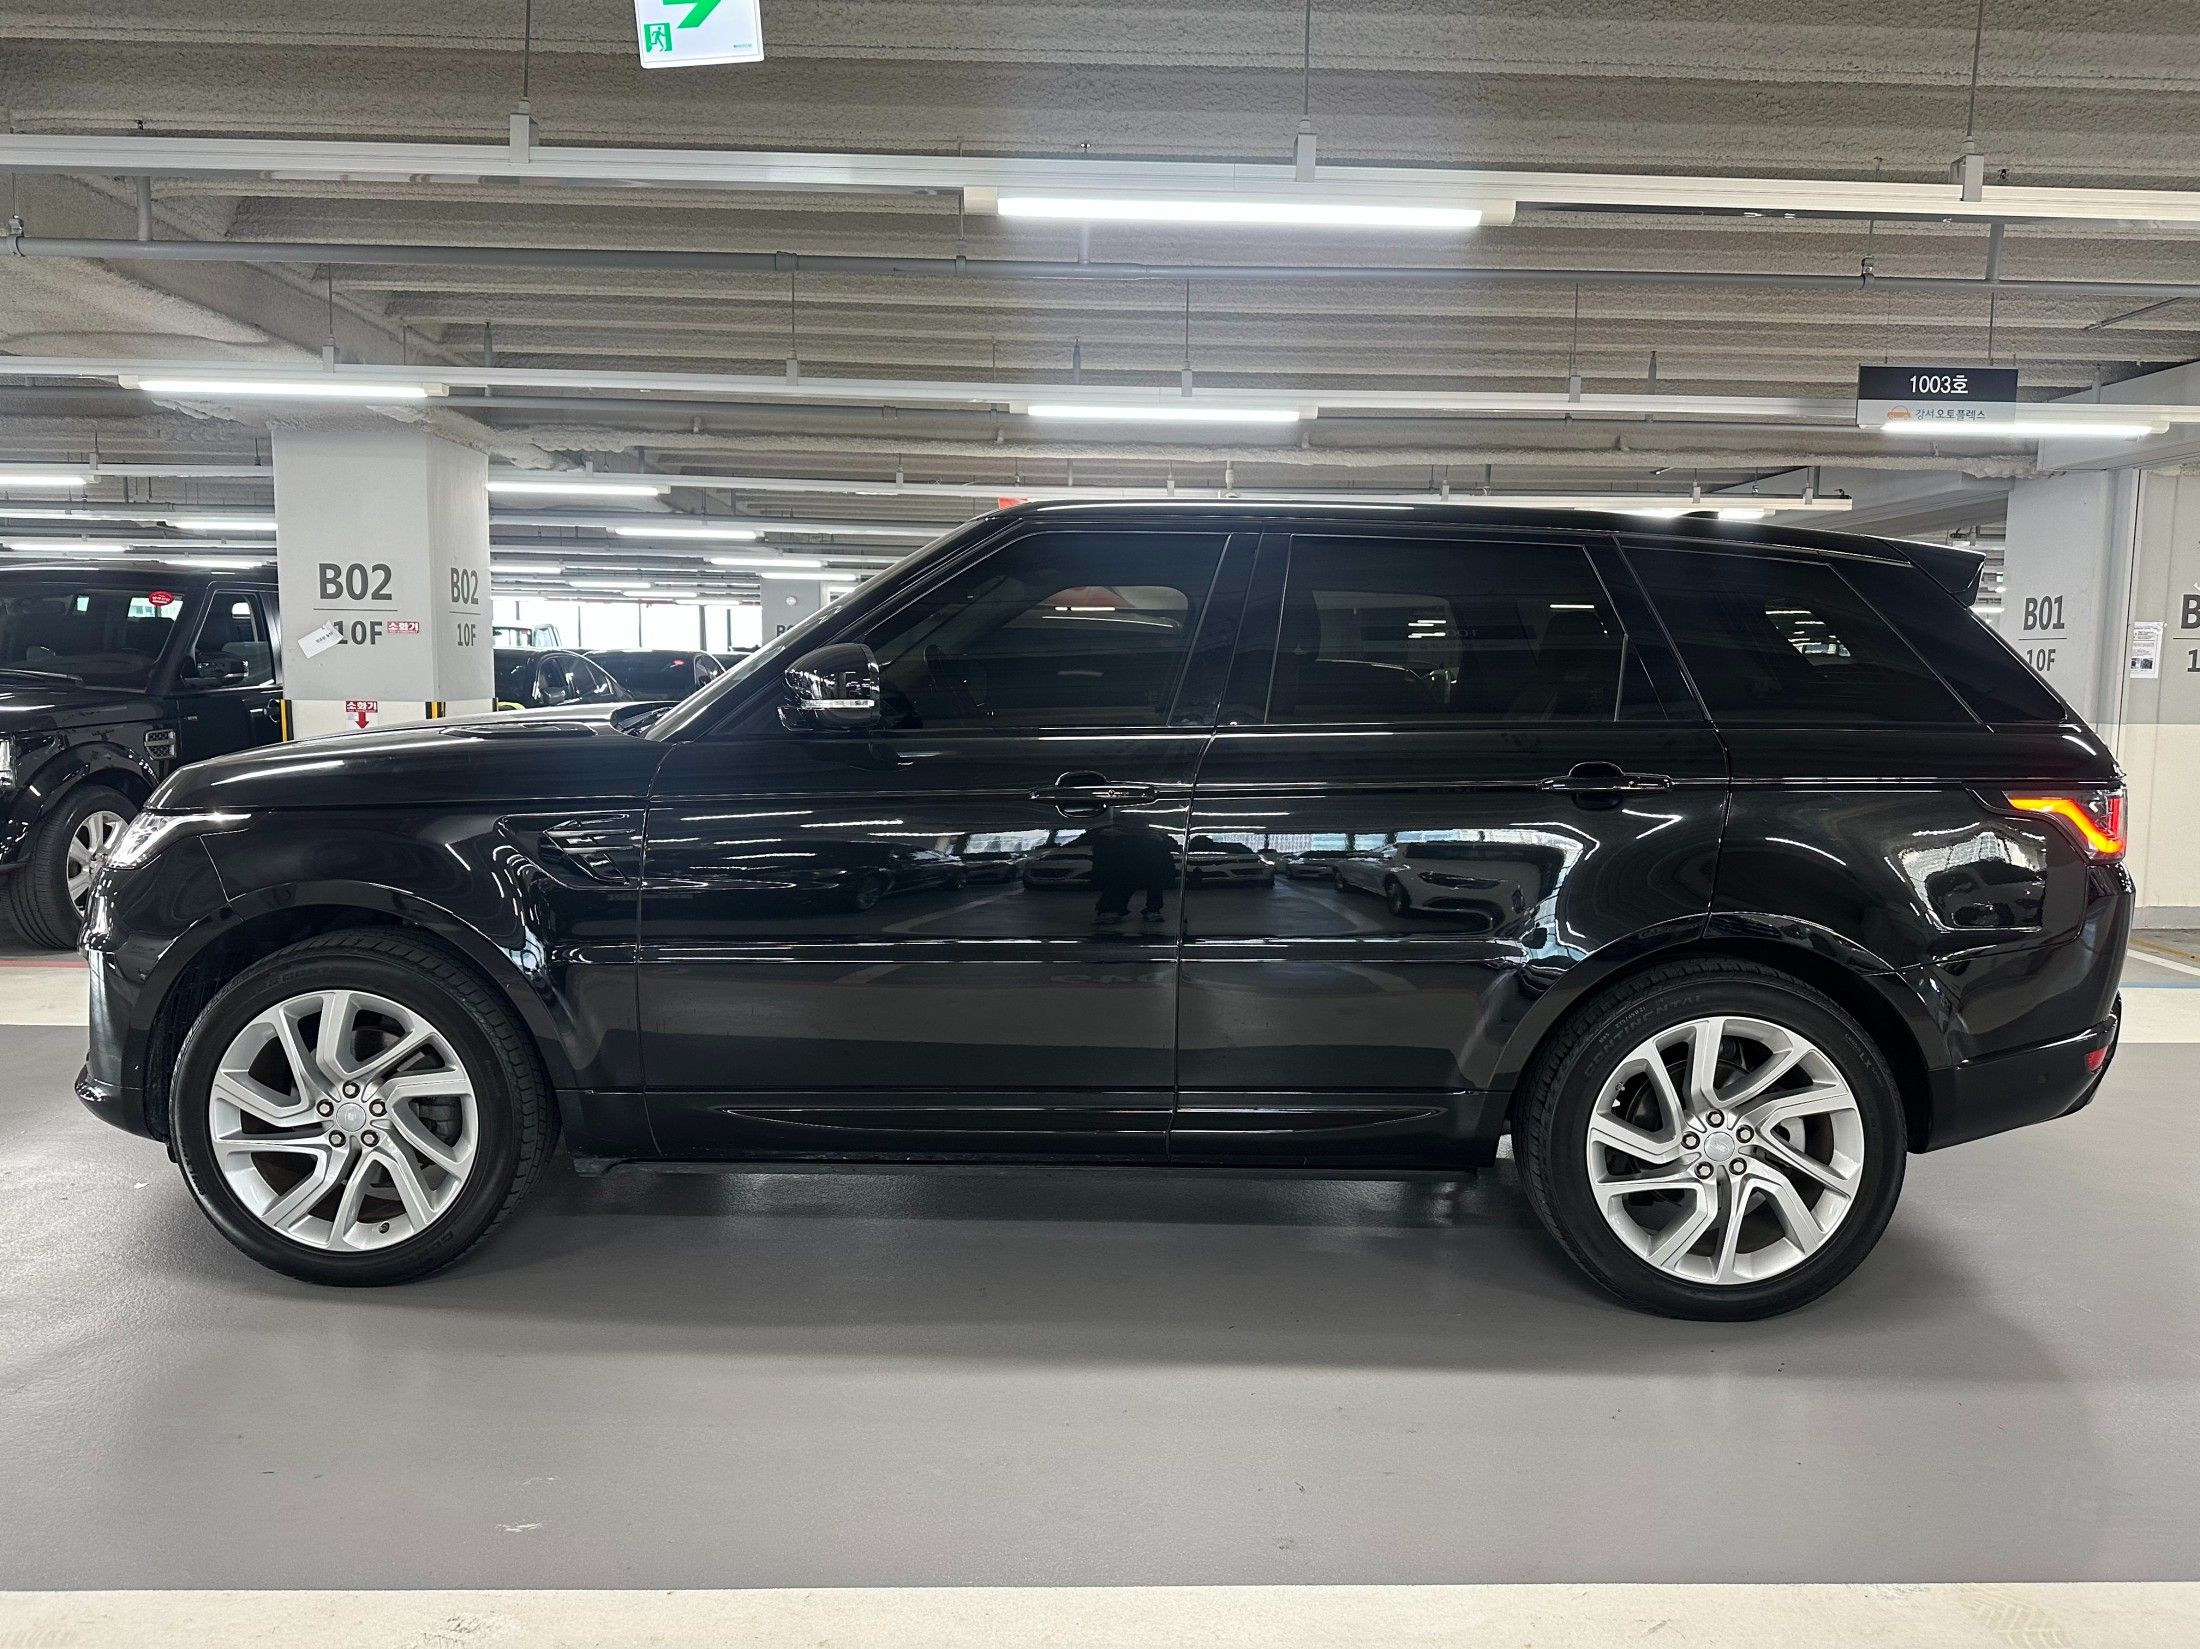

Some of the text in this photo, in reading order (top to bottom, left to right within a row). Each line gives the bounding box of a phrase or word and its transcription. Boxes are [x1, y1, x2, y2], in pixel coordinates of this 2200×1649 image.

[1910, 375, 1968, 394] 1003호
[1915, 409, 1986, 421] 강서오토플렉스
[318, 563, 393, 600] B02
[450, 567, 479, 604] B02
[2023, 595, 2065, 630] B01
[333, 620, 383, 645] 10F
[388, 622, 419, 632] 소화기
[457, 623, 476, 646] 10F
[2026, 648, 2056, 672] 10F
[346, 701, 377, 710] 소화기
